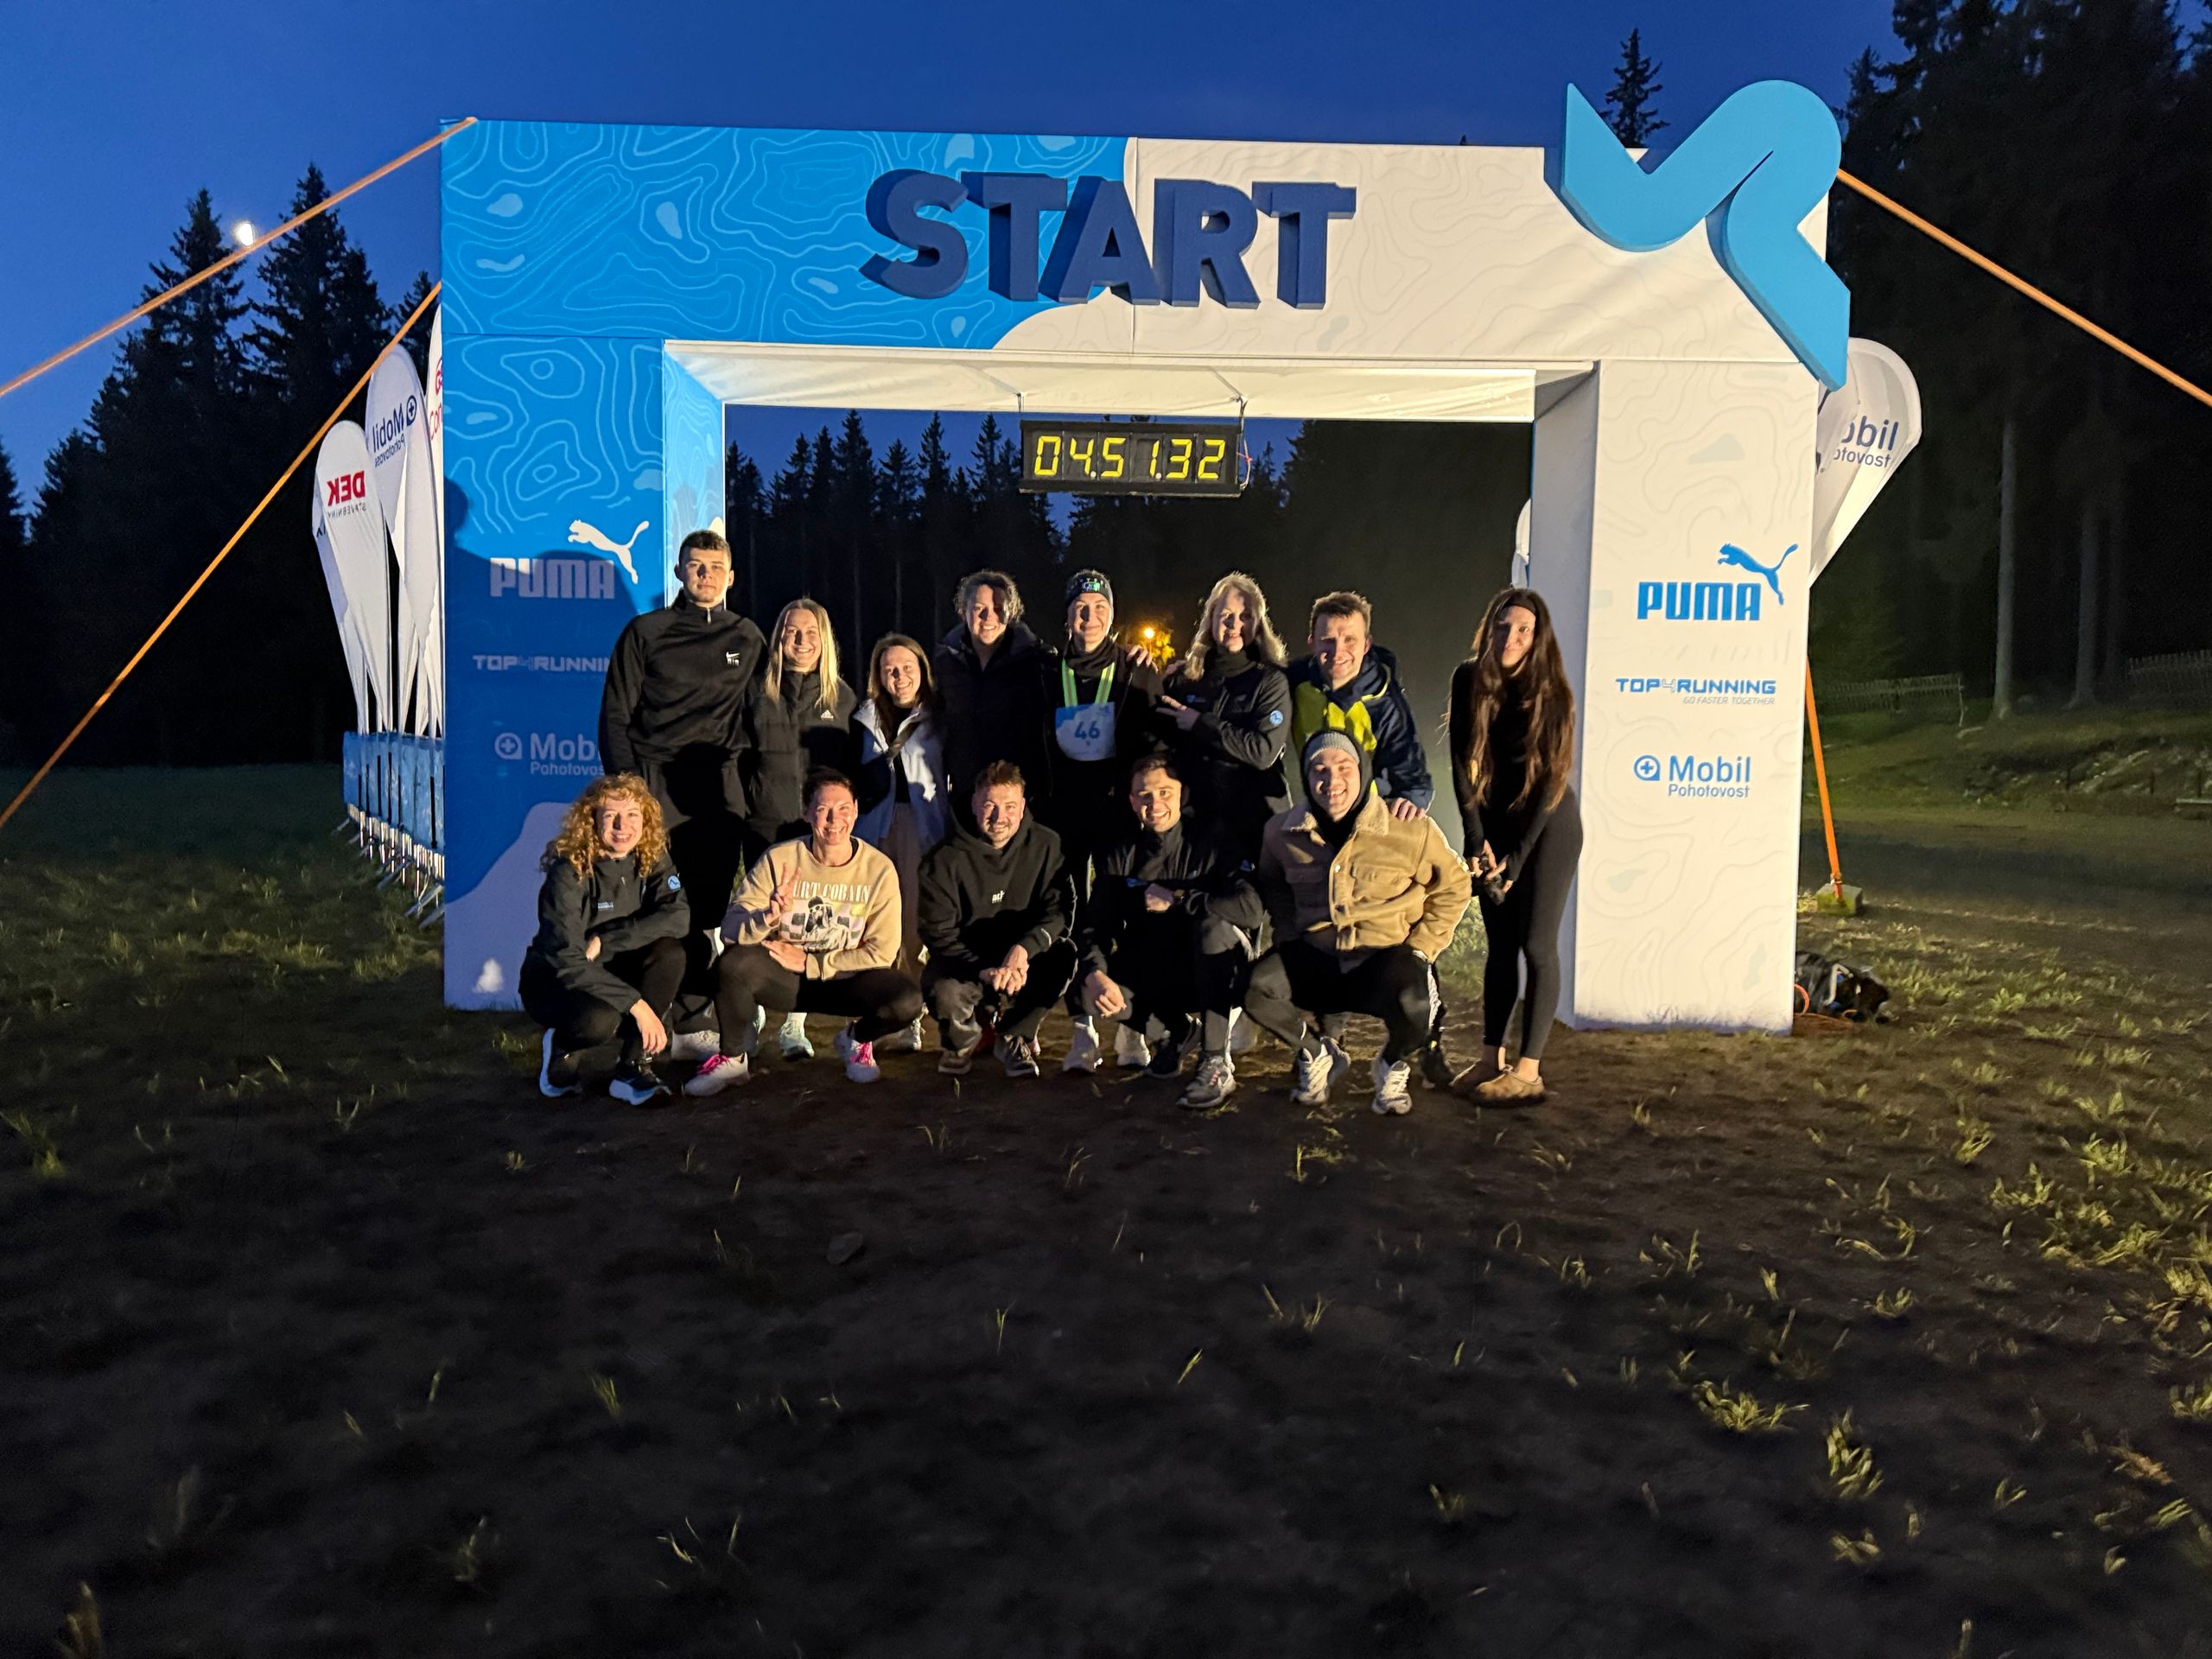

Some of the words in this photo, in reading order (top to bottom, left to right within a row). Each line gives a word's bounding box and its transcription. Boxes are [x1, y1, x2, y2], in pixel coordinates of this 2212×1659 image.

[859, 168, 1357, 309] START
[1833, 447, 1891, 467] otovost
[490, 557, 615, 599] PUMA
[1637, 582, 1761, 620] PUMA
[1615, 677, 1777, 695] TOP4RUNNING
[1682, 696, 1694, 705] GO
[1696, 696, 1729, 705] FASTER
[1732, 696, 1776, 706] TOGETHER
[1074, 721, 1101, 741] 46
[530, 732, 596, 761] Mob
[530, 760, 605, 776] Pohotovos
[1669, 754, 1751, 783] Mobil
[1668, 783, 1751, 798] Pohotovost
[792, 880, 821, 899] URT
[822, 882, 872, 904] COBAIN
